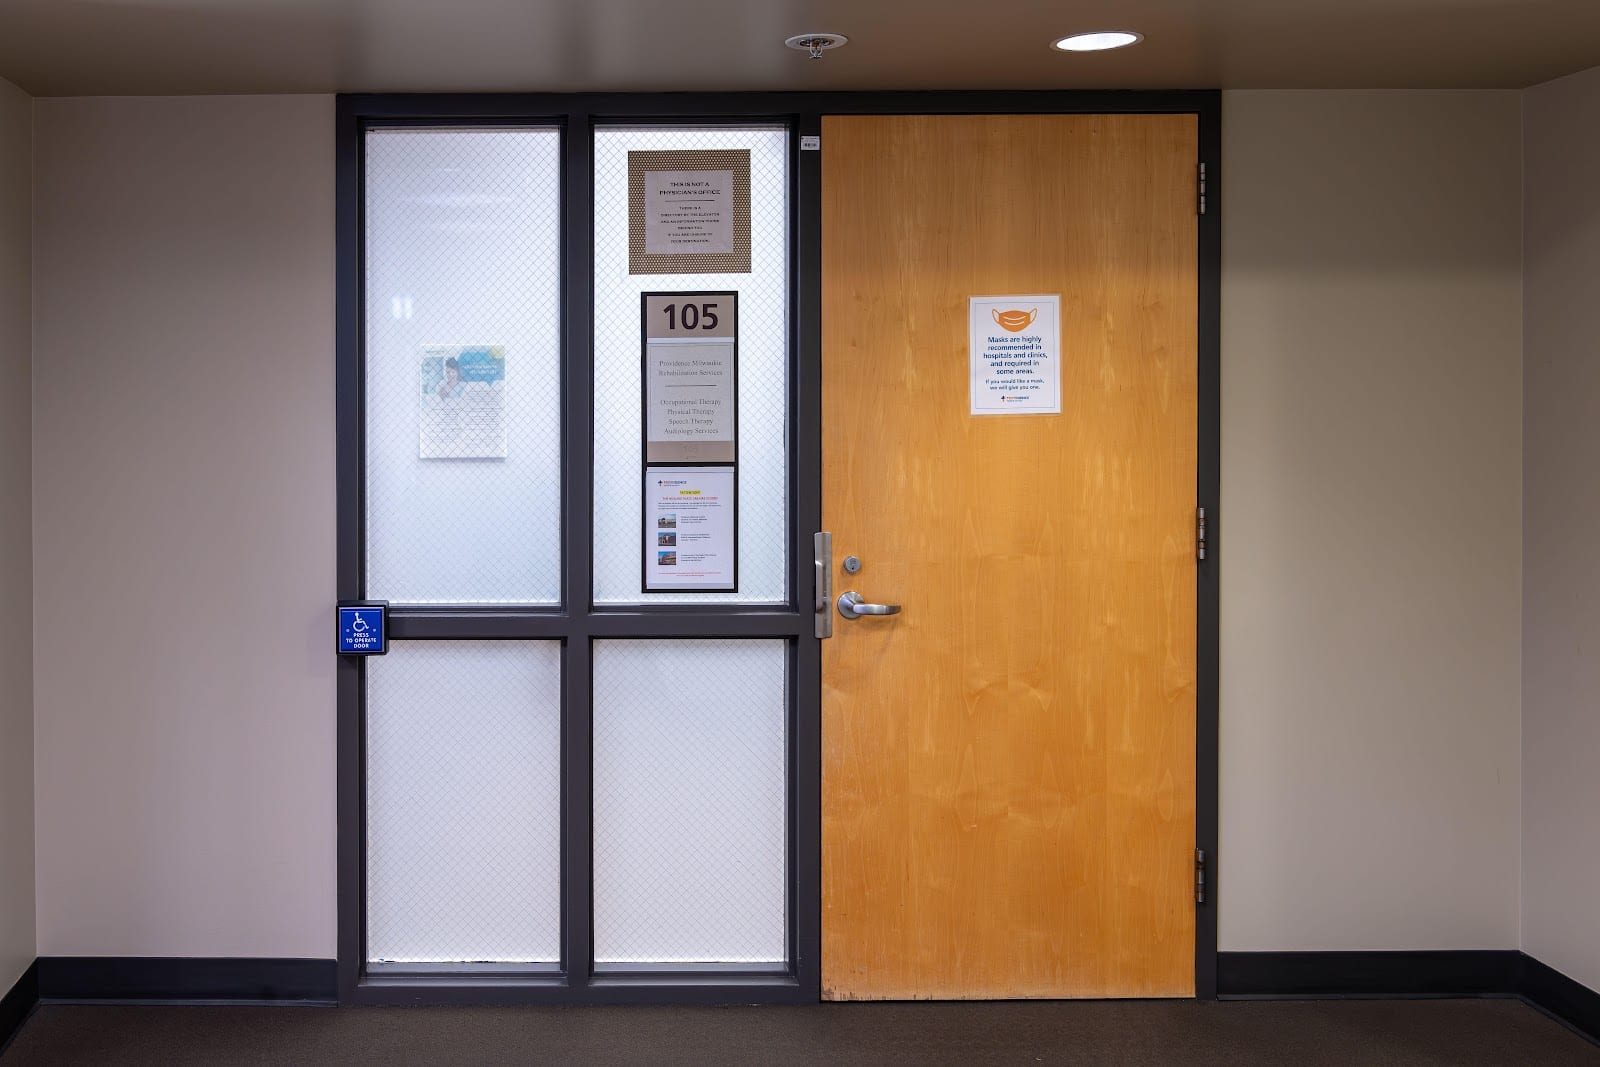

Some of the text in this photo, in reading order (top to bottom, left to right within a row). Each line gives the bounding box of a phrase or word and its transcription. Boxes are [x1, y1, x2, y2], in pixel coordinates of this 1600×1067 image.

[663, 303, 719, 330] 105
[983, 352, 1012, 360] hospitals
[692, 408, 715, 416] Therapy
[691, 418, 713, 426] Therapy
